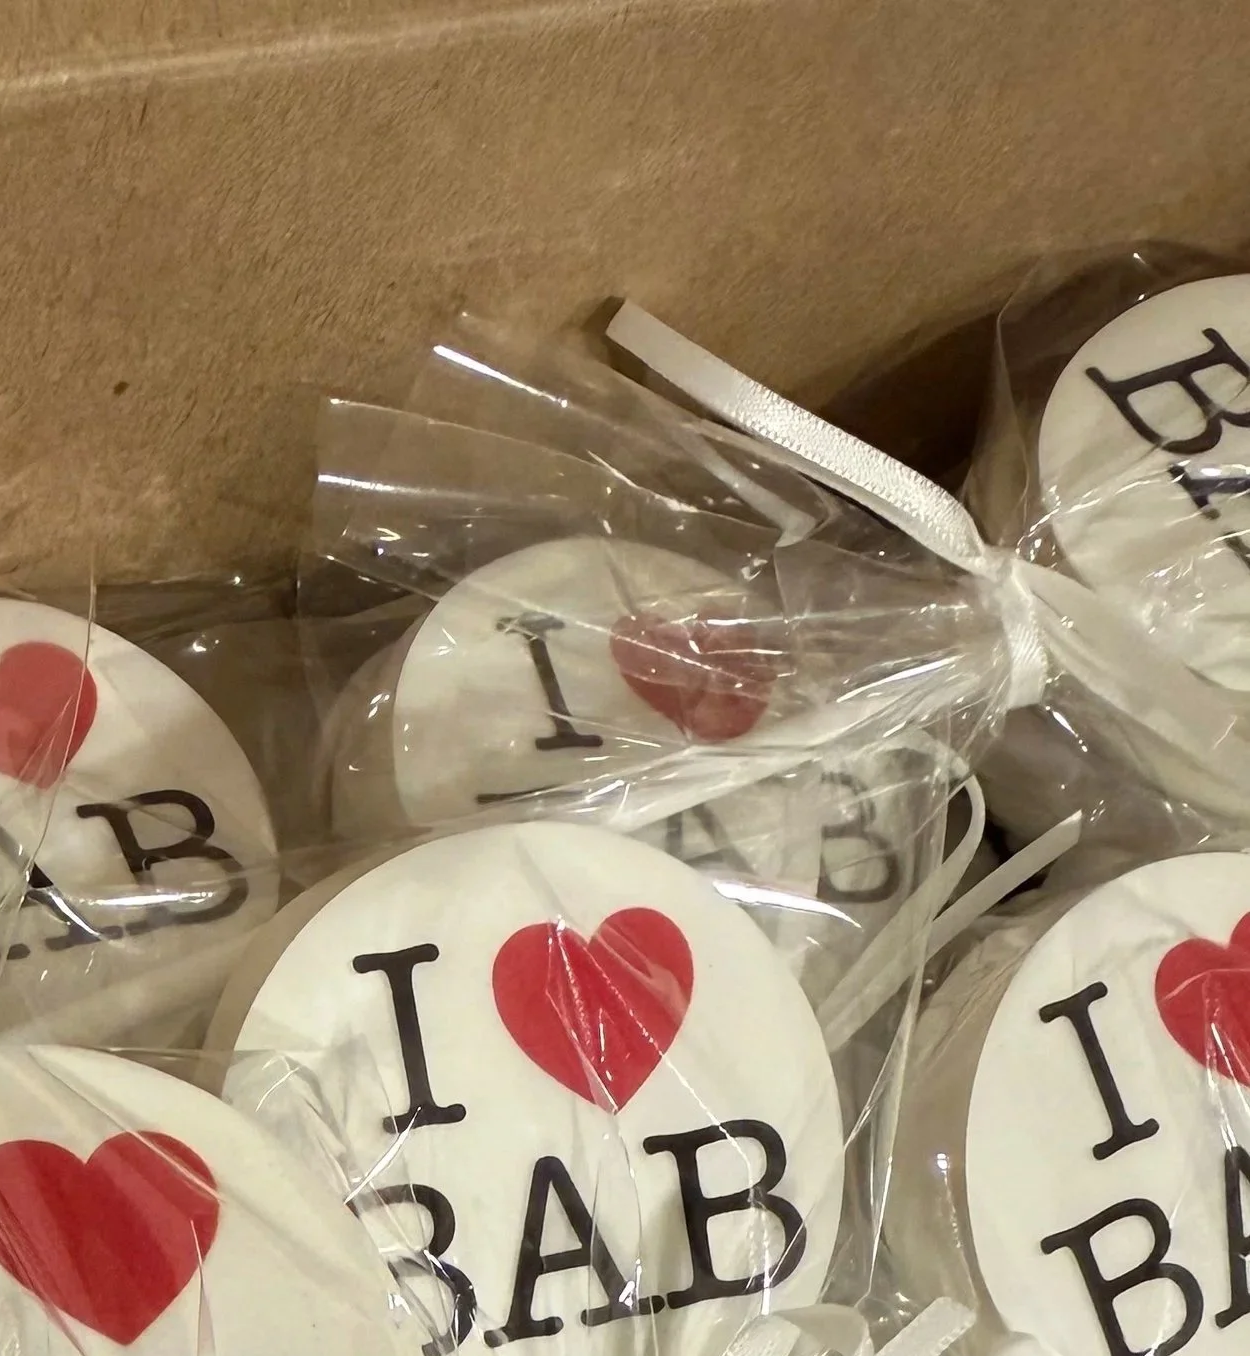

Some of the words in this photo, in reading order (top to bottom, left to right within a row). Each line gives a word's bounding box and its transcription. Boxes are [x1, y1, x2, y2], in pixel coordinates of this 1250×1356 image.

[495, 611, 604, 751] I
[352, 943, 467, 1134] I
[1039, 981, 1160, 1161] I
